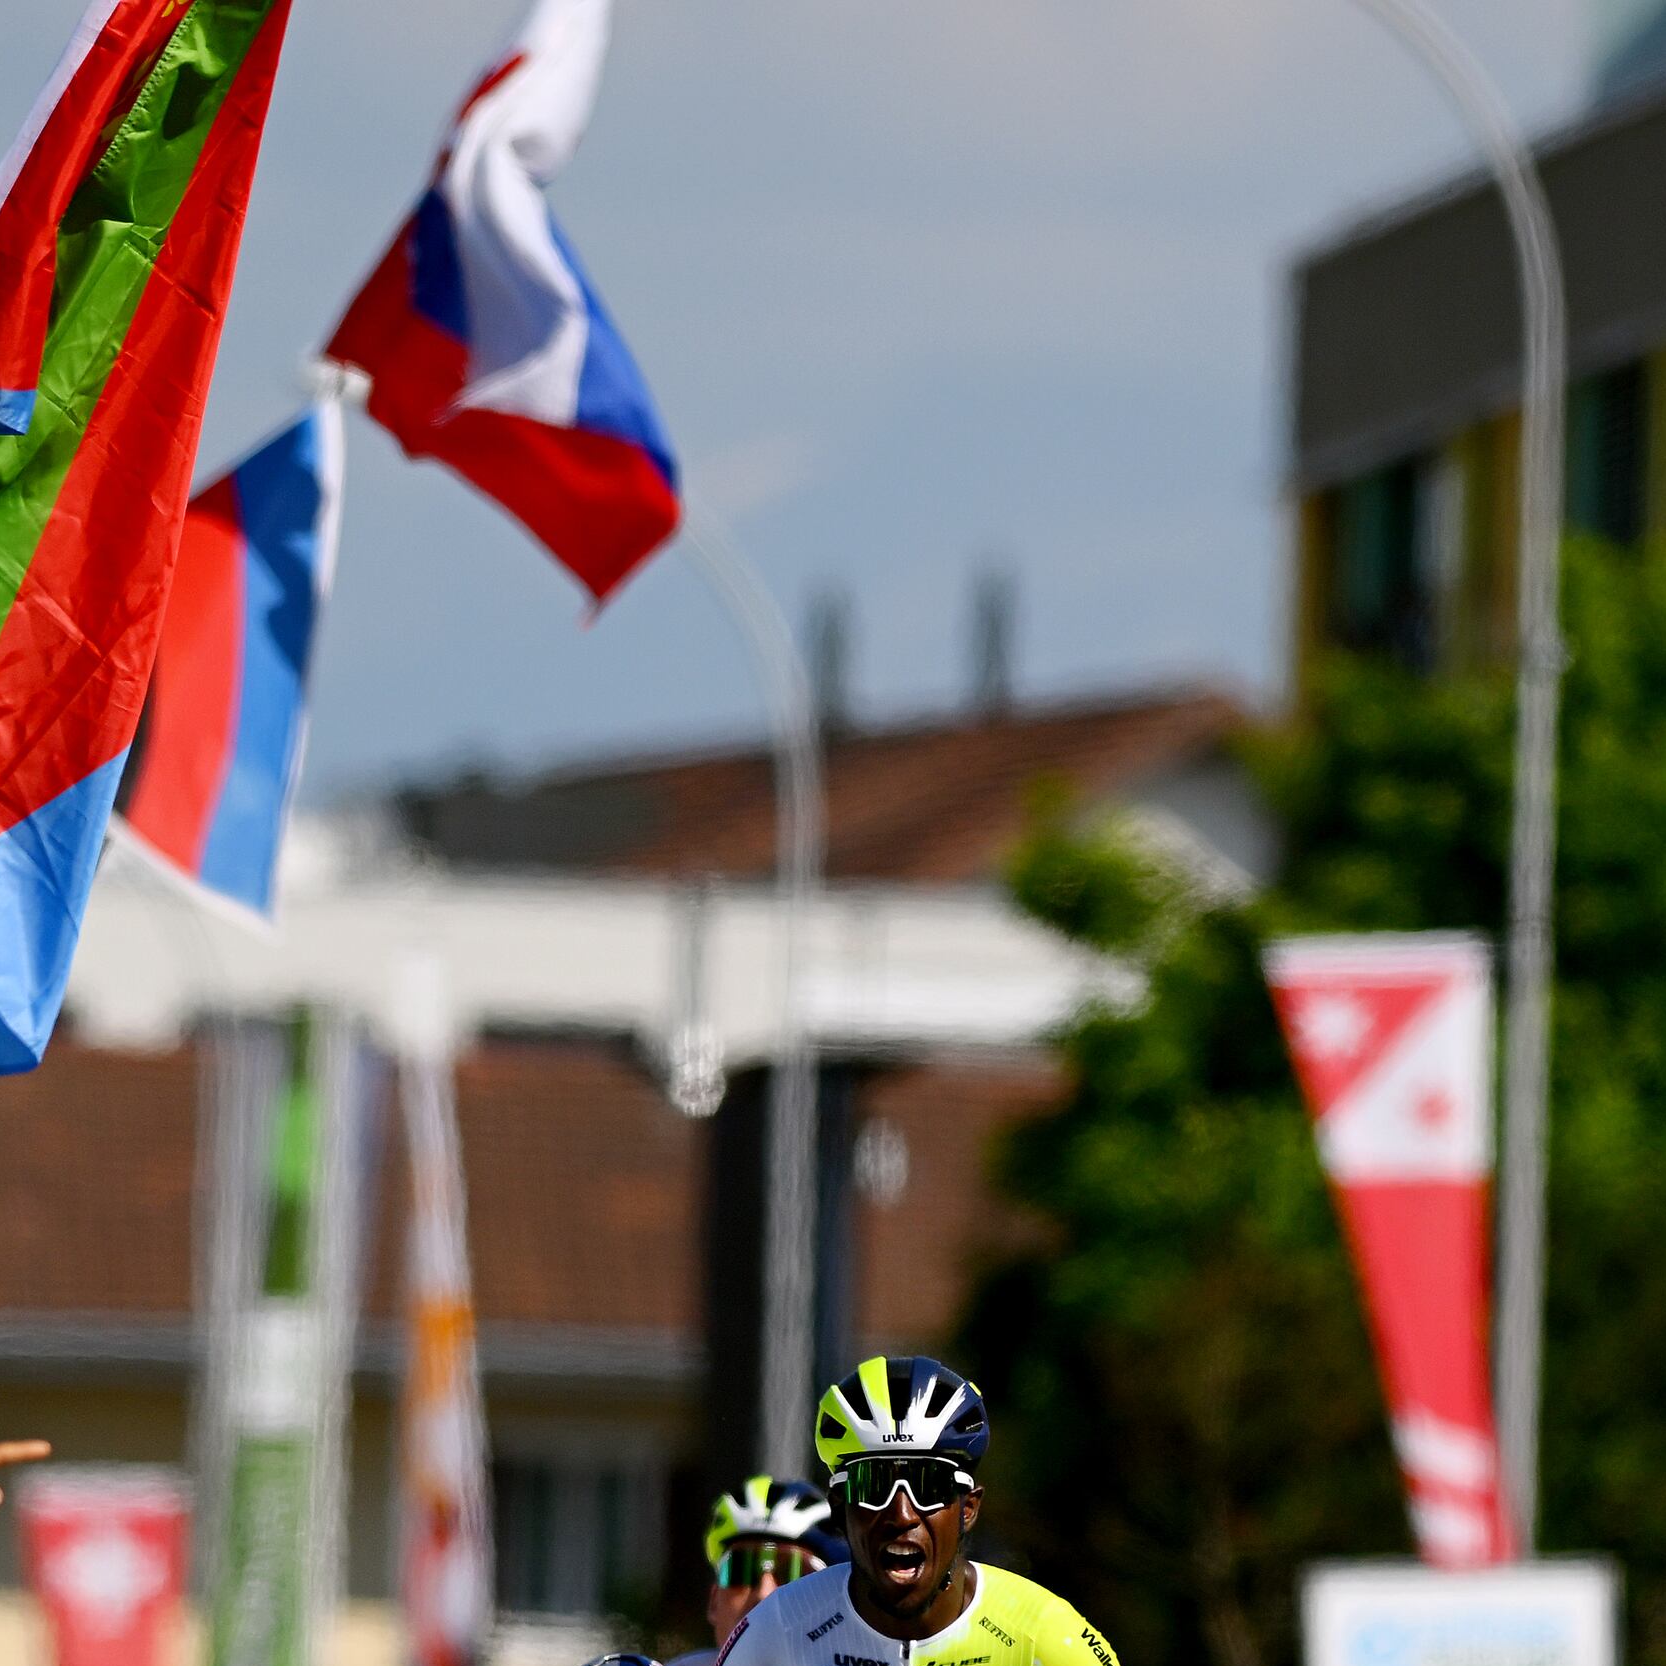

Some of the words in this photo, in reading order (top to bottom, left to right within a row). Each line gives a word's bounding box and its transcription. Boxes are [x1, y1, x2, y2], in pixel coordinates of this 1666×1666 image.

[883, 1433, 914, 1443] uvex
[807, 1612, 844, 1642] RUFFUS
[978, 1616, 1016, 1647] RUFFUS
